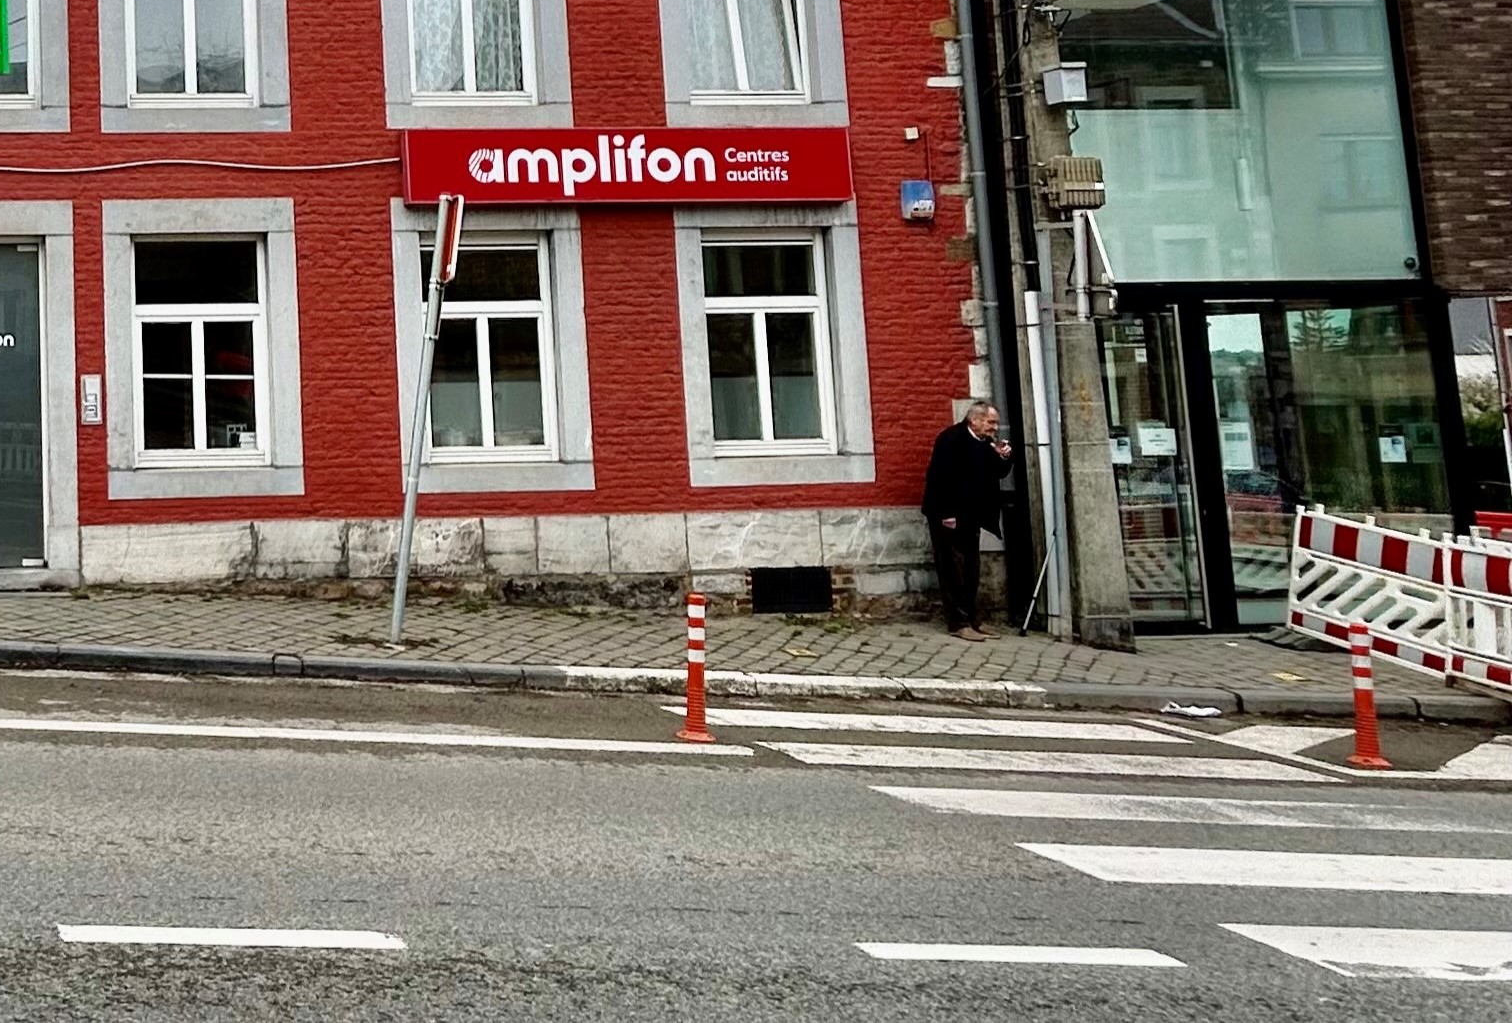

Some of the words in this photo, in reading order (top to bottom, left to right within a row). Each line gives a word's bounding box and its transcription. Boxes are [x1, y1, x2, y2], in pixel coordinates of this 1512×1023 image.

[724, 147, 789, 163] Centres
[468, 134, 716, 196] amplifon
[726, 166, 788, 182] auditifs
